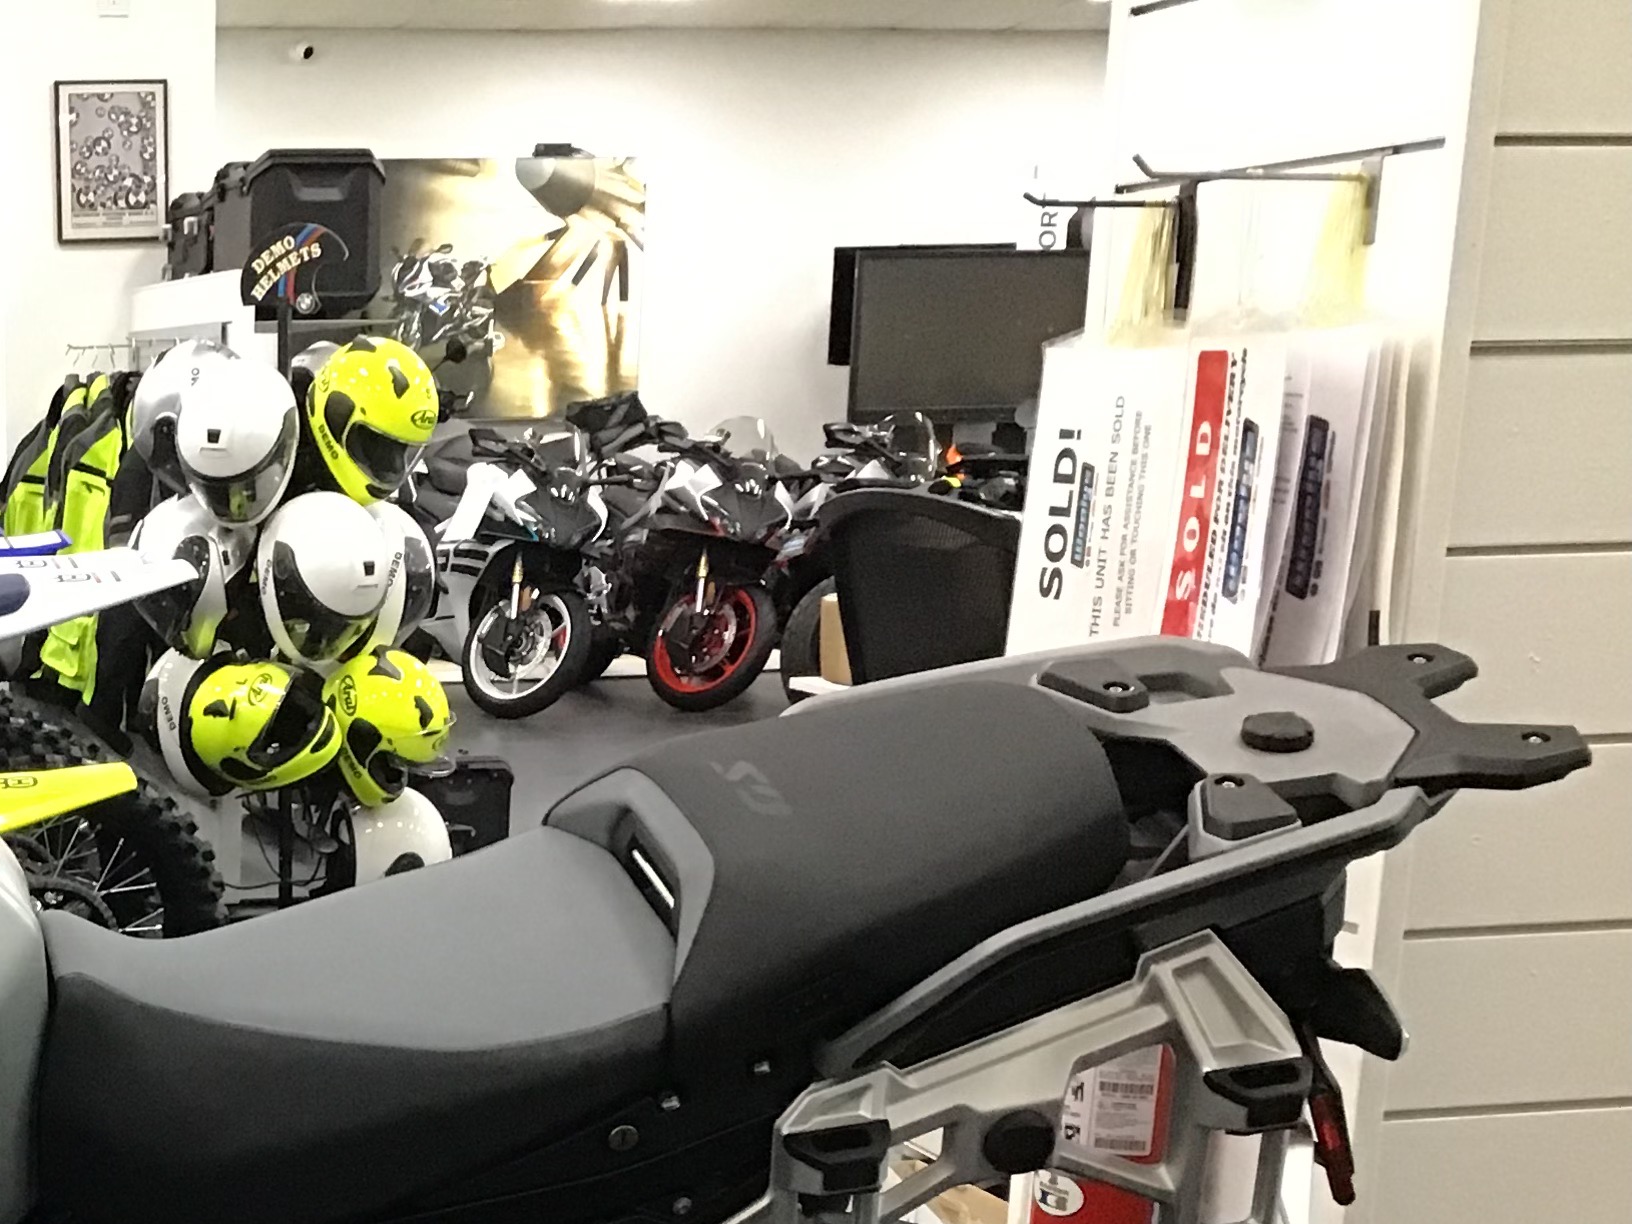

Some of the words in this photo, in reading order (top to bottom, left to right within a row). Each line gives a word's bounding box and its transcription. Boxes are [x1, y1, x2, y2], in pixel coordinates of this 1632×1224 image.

[250, 243, 321, 301] HELMETS
[251, 235, 295, 274] DEMO
[1111, 396, 1125, 444] SOLD
[1131, 410, 1143, 455] BEFORE
[1142, 425, 1152, 449] ONE
[318, 423, 339, 460] DEMO
[1105, 451, 1118, 497] BEEN
[1138, 452, 1149, 480] THIS
[1039, 428, 1082, 600] SOLD!
[1122, 459, 1137, 530] ASSISTANCE
[1131, 484, 1145, 545] TOUCHING
[1175, 420, 1212, 600] SOLD
[1100, 504, 1112, 540] HAS
[1120, 534, 1128, 556] FOR
[1129, 548, 1137, 565] OR
[387, 552, 403, 587] DEMO
[1095, 547, 1107, 589] UNIT
[1117, 560, 1125, 582] ASK
[1089, 596, 1103, 637] THIS
[1113, 587, 1123, 627] PLEASE
[161, 696, 177, 731] DEMO
